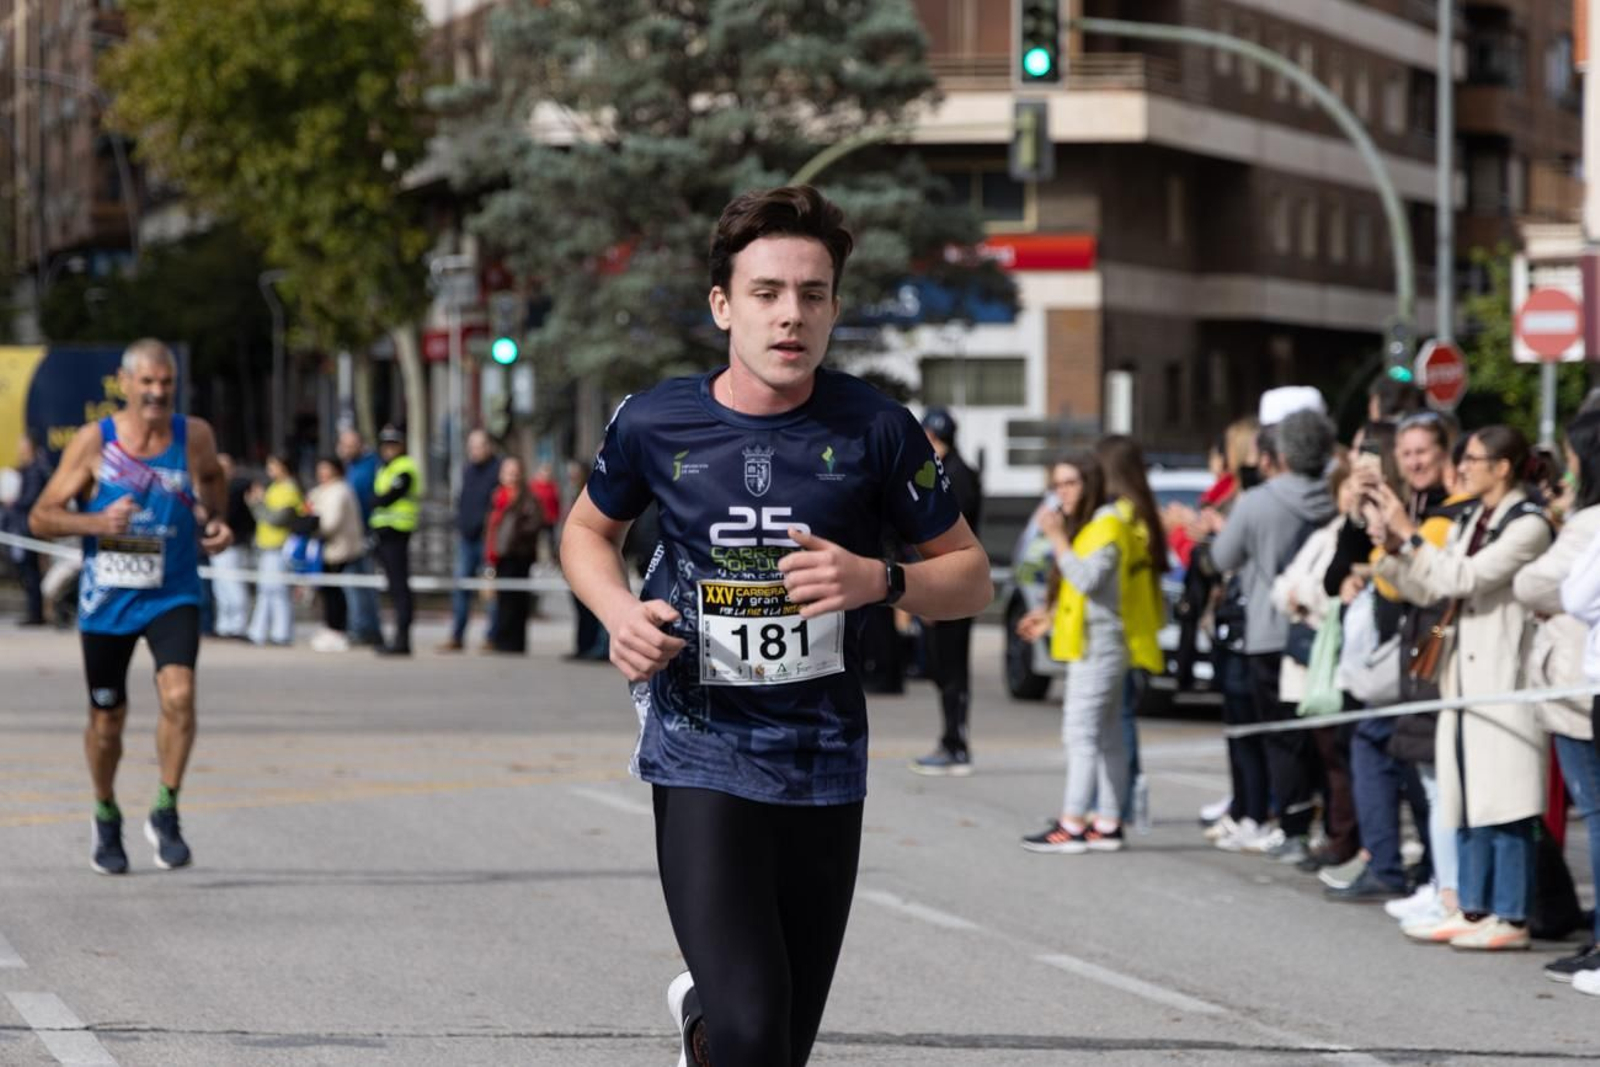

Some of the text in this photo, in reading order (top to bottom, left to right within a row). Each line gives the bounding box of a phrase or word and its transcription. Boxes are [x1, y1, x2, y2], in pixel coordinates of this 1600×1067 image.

[709, 506, 811, 547] 25
[705, 586, 785, 605] XXV CARRERA
[735, 597, 743, 606] y
[749, 597, 779, 605] gran
[731, 619, 809, 661] 181
